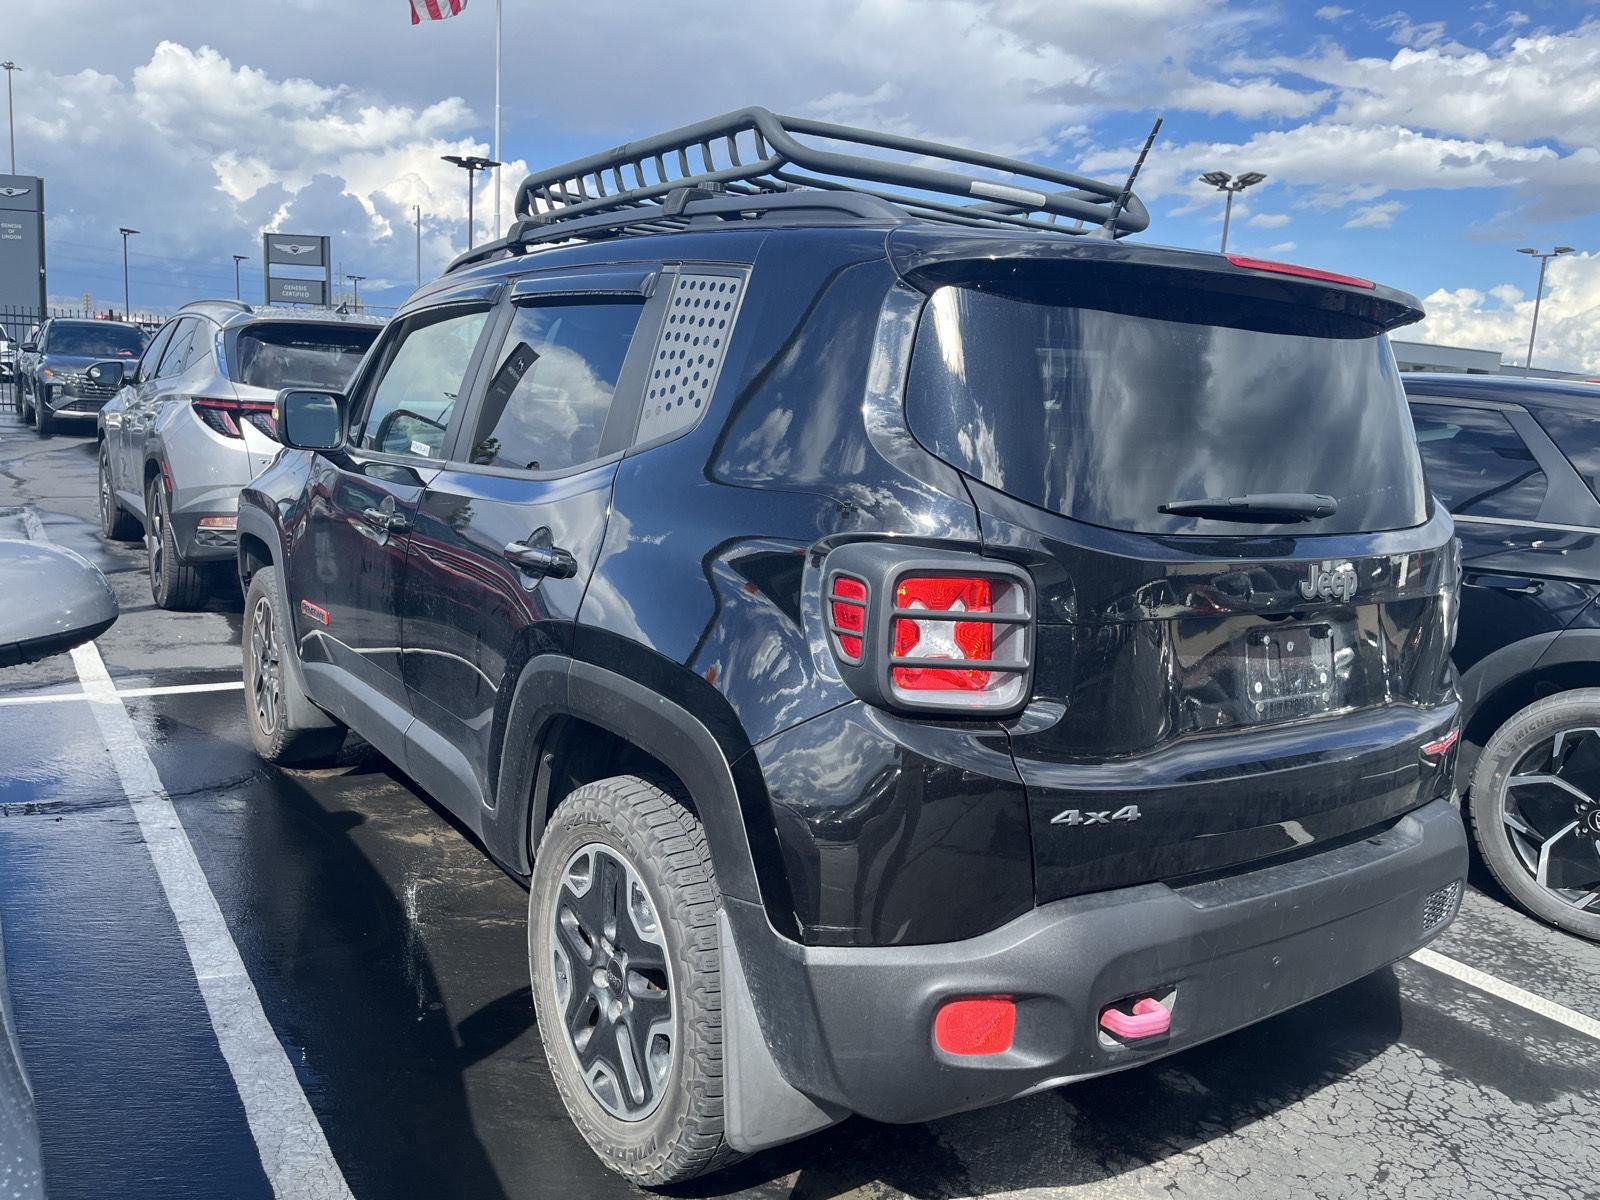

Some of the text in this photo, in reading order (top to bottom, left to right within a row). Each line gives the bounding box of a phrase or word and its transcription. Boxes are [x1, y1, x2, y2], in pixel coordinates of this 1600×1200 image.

[281, 290, 310, 298] CERTIFIED
[1300, 563, 1358, 603] Jeep
[1050, 804, 1142, 826] 4x4
[563, 810, 639, 860] FALKEN
